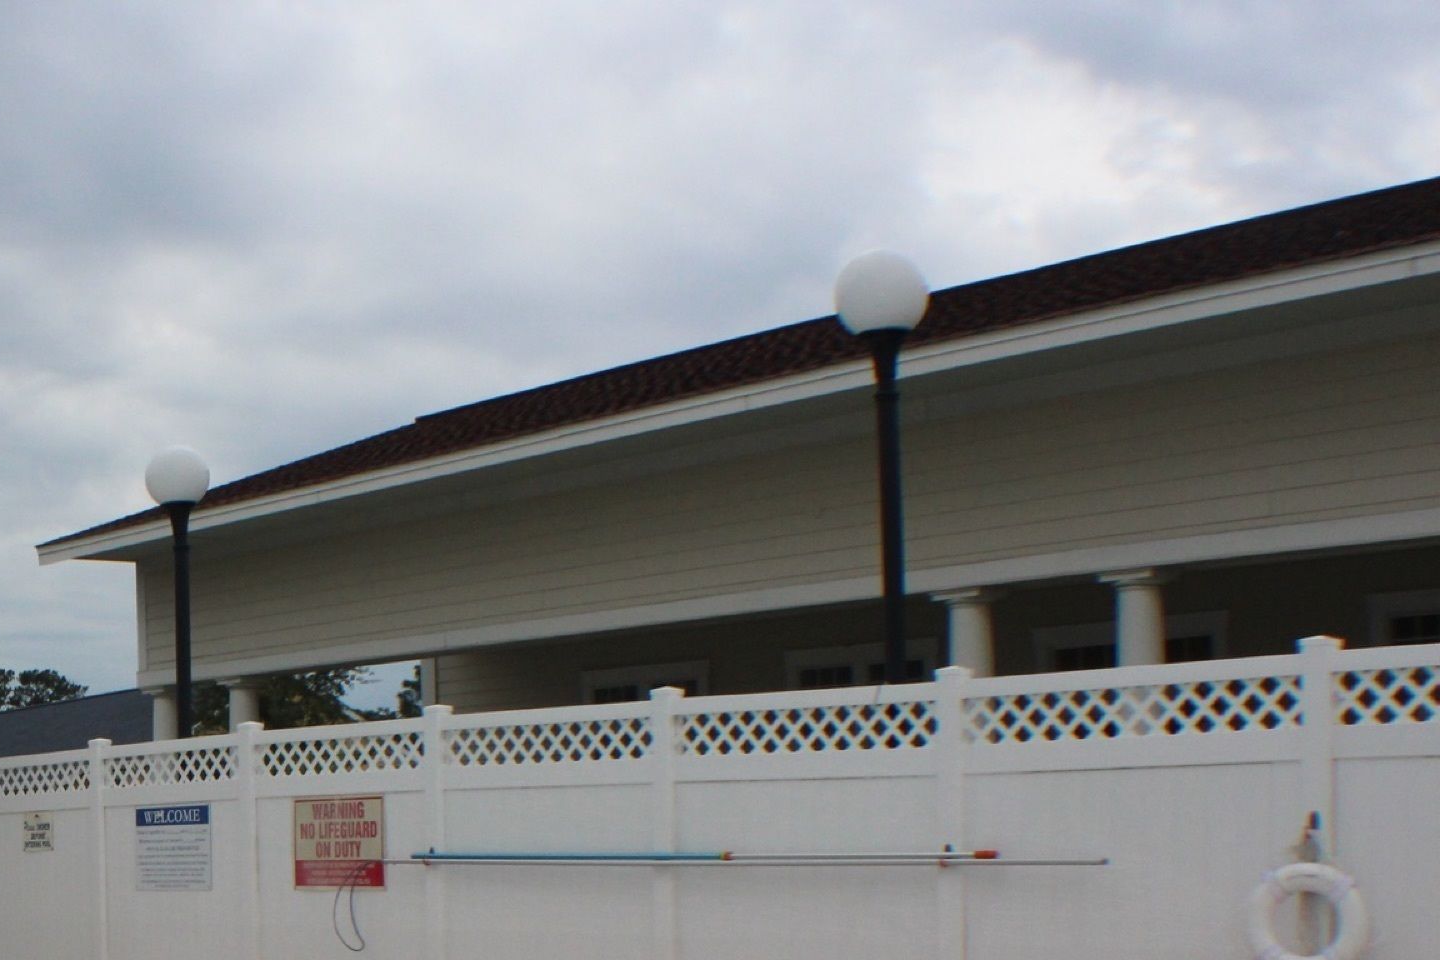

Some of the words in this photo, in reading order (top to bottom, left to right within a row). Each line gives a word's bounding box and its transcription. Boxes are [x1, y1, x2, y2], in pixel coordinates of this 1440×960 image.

[144, 808, 201, 824] WELCOME
[312, 801, 365, 820] WARNING
[300, 823, 315, 839] NO
[318, 820, 377, 839] LIFEGUARD
[315, 841, 331, 858] ON
[334, 840, 361, 858] DUTY
